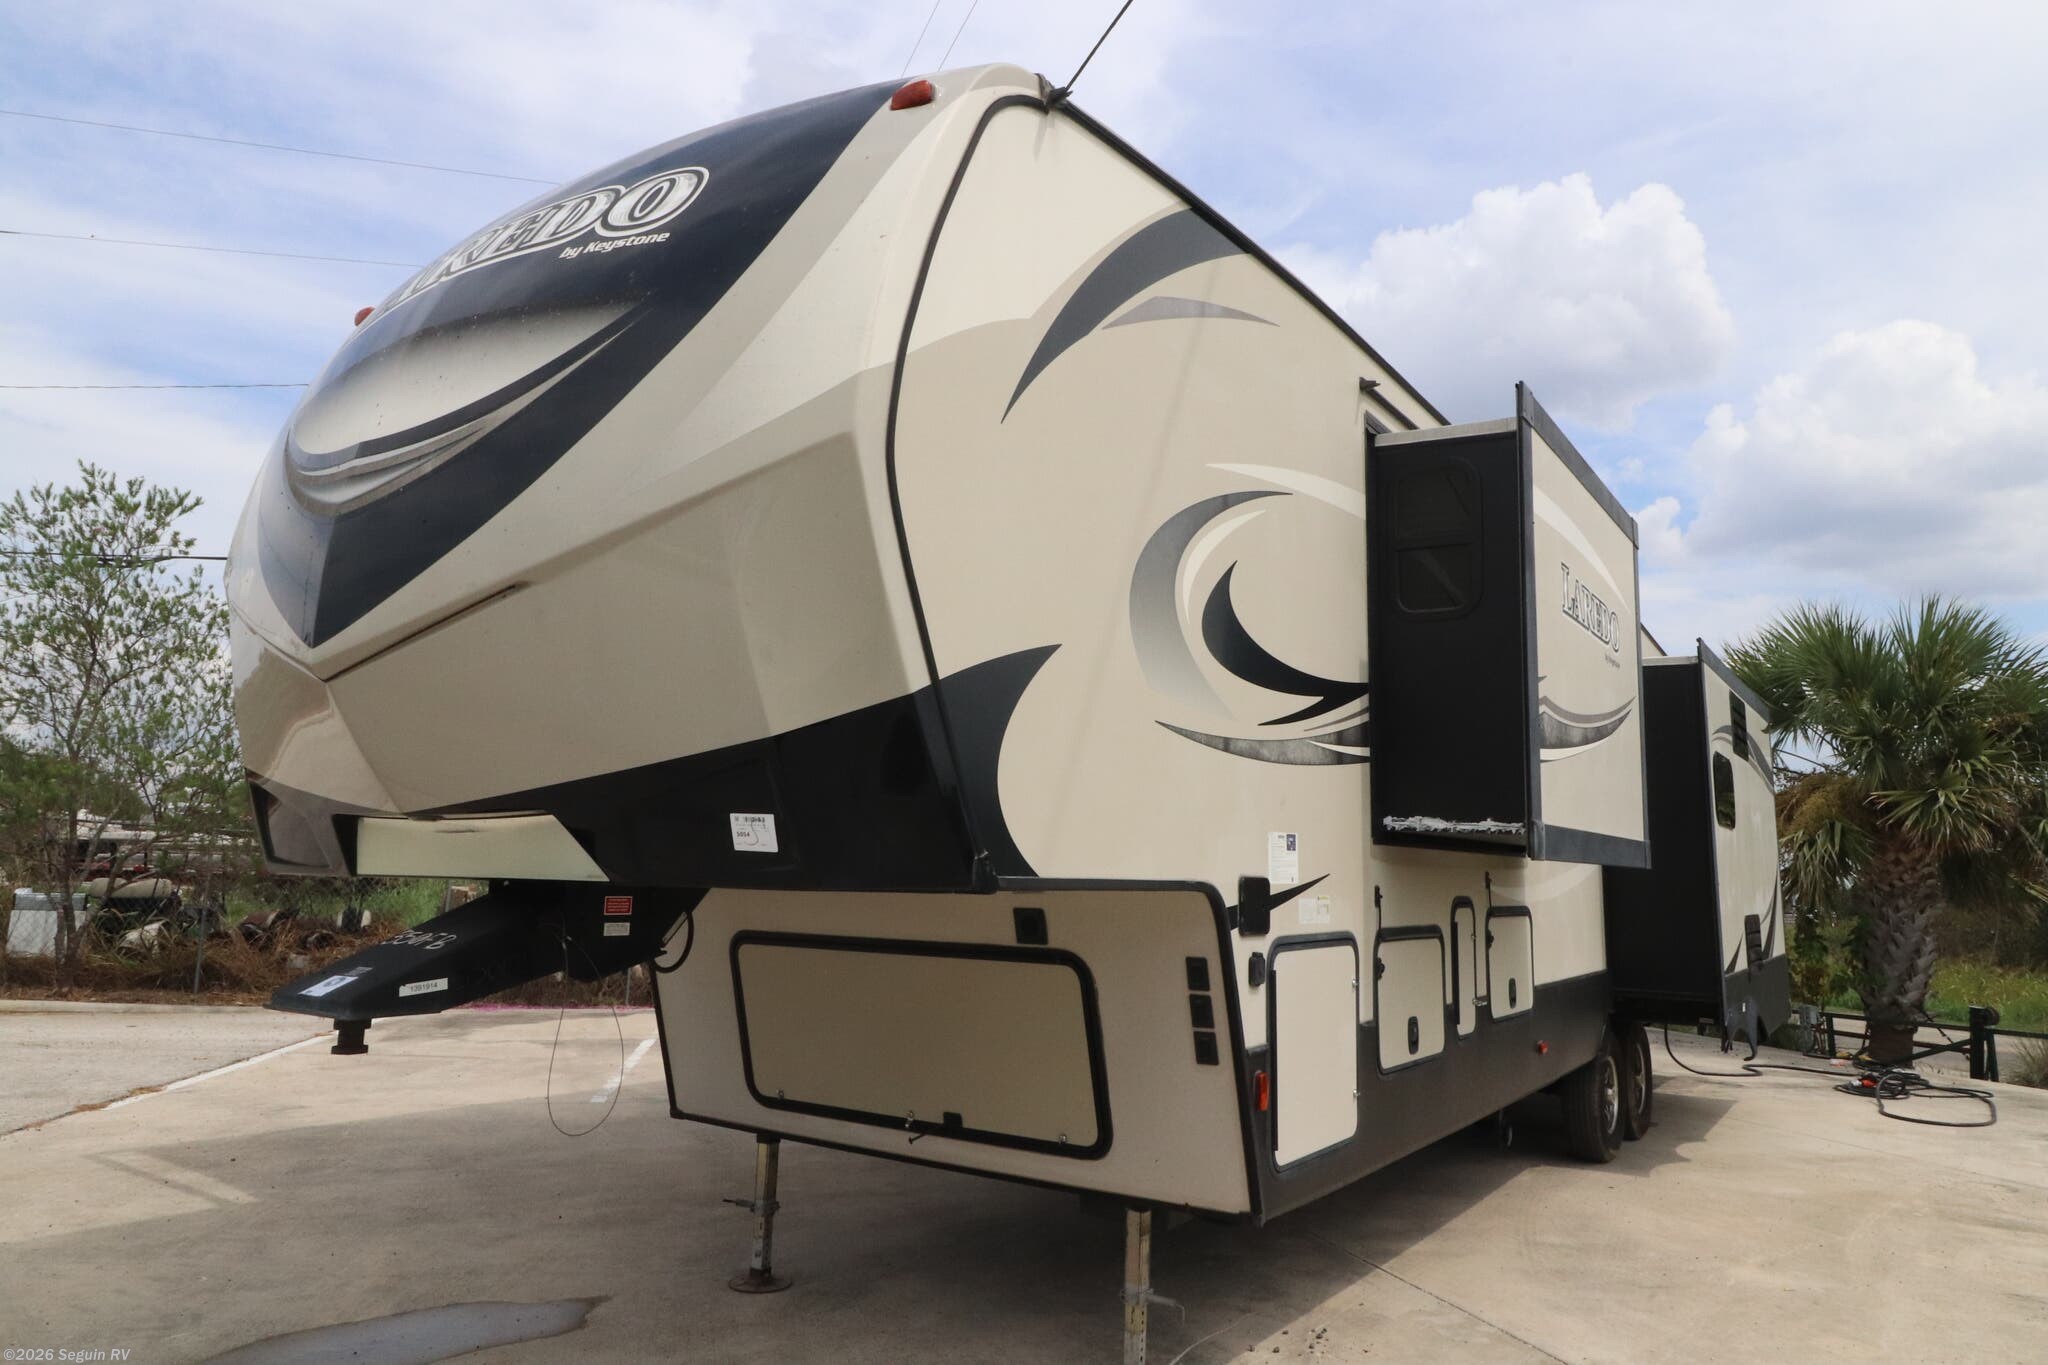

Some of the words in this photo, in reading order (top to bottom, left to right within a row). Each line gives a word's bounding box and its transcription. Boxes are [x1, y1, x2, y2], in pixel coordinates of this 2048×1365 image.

[559, 245, 581, 260] by
[582, 231, 671, 255] Keystone
[1560, 561, 1620, 653] LAREDO
